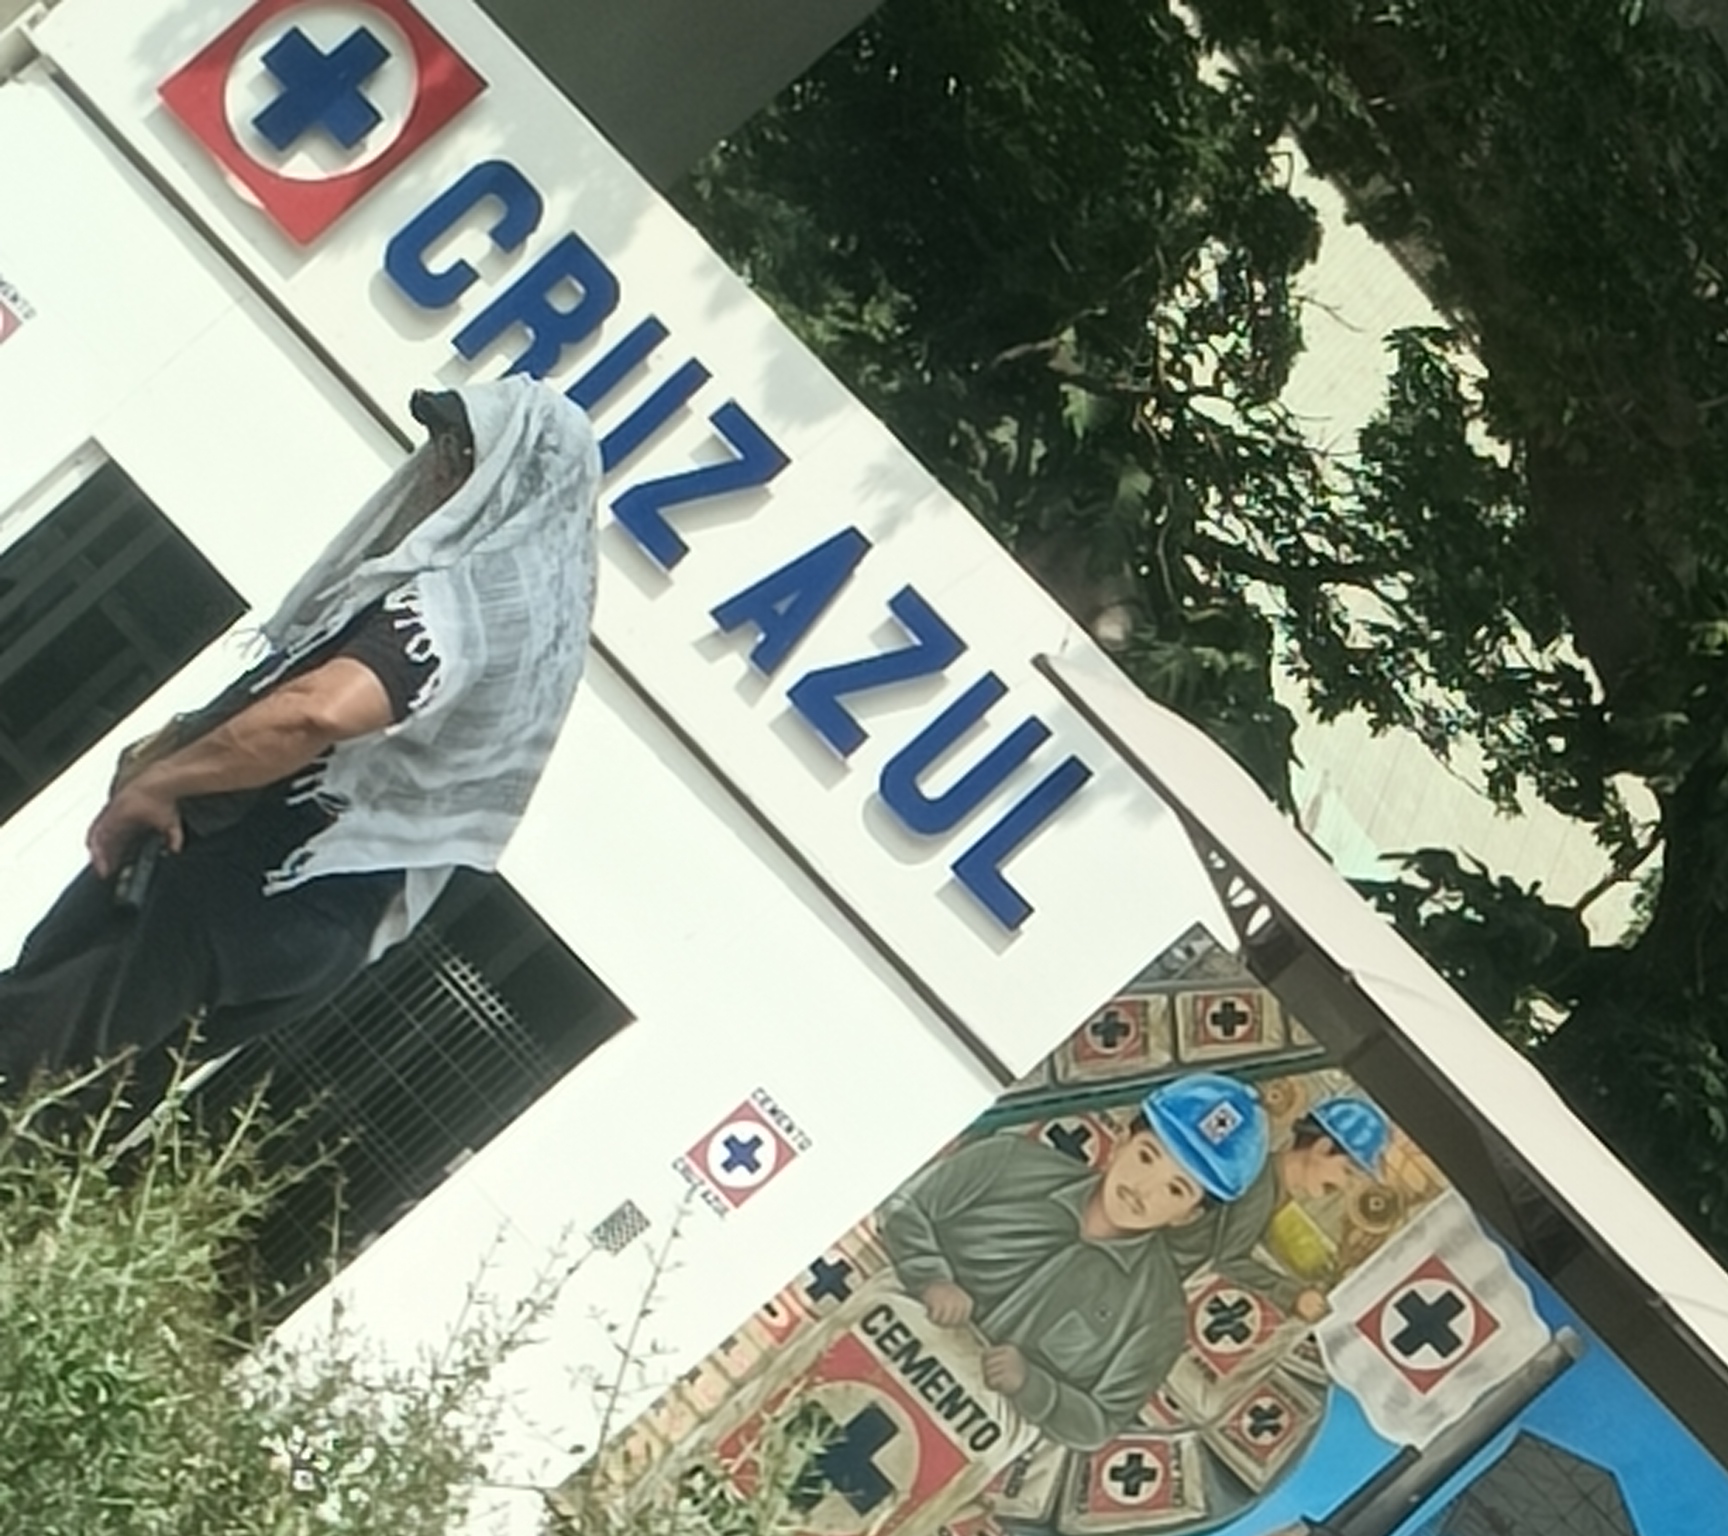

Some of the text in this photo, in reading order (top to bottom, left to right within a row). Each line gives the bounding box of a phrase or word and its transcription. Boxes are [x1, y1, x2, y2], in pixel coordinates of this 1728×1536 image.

[384, 158, 1093, 932] CRUZ AZUL
[750, 1086, 813, 1152] CEMENTO
[860, 1303, 1001, 1453] CEMENTO
